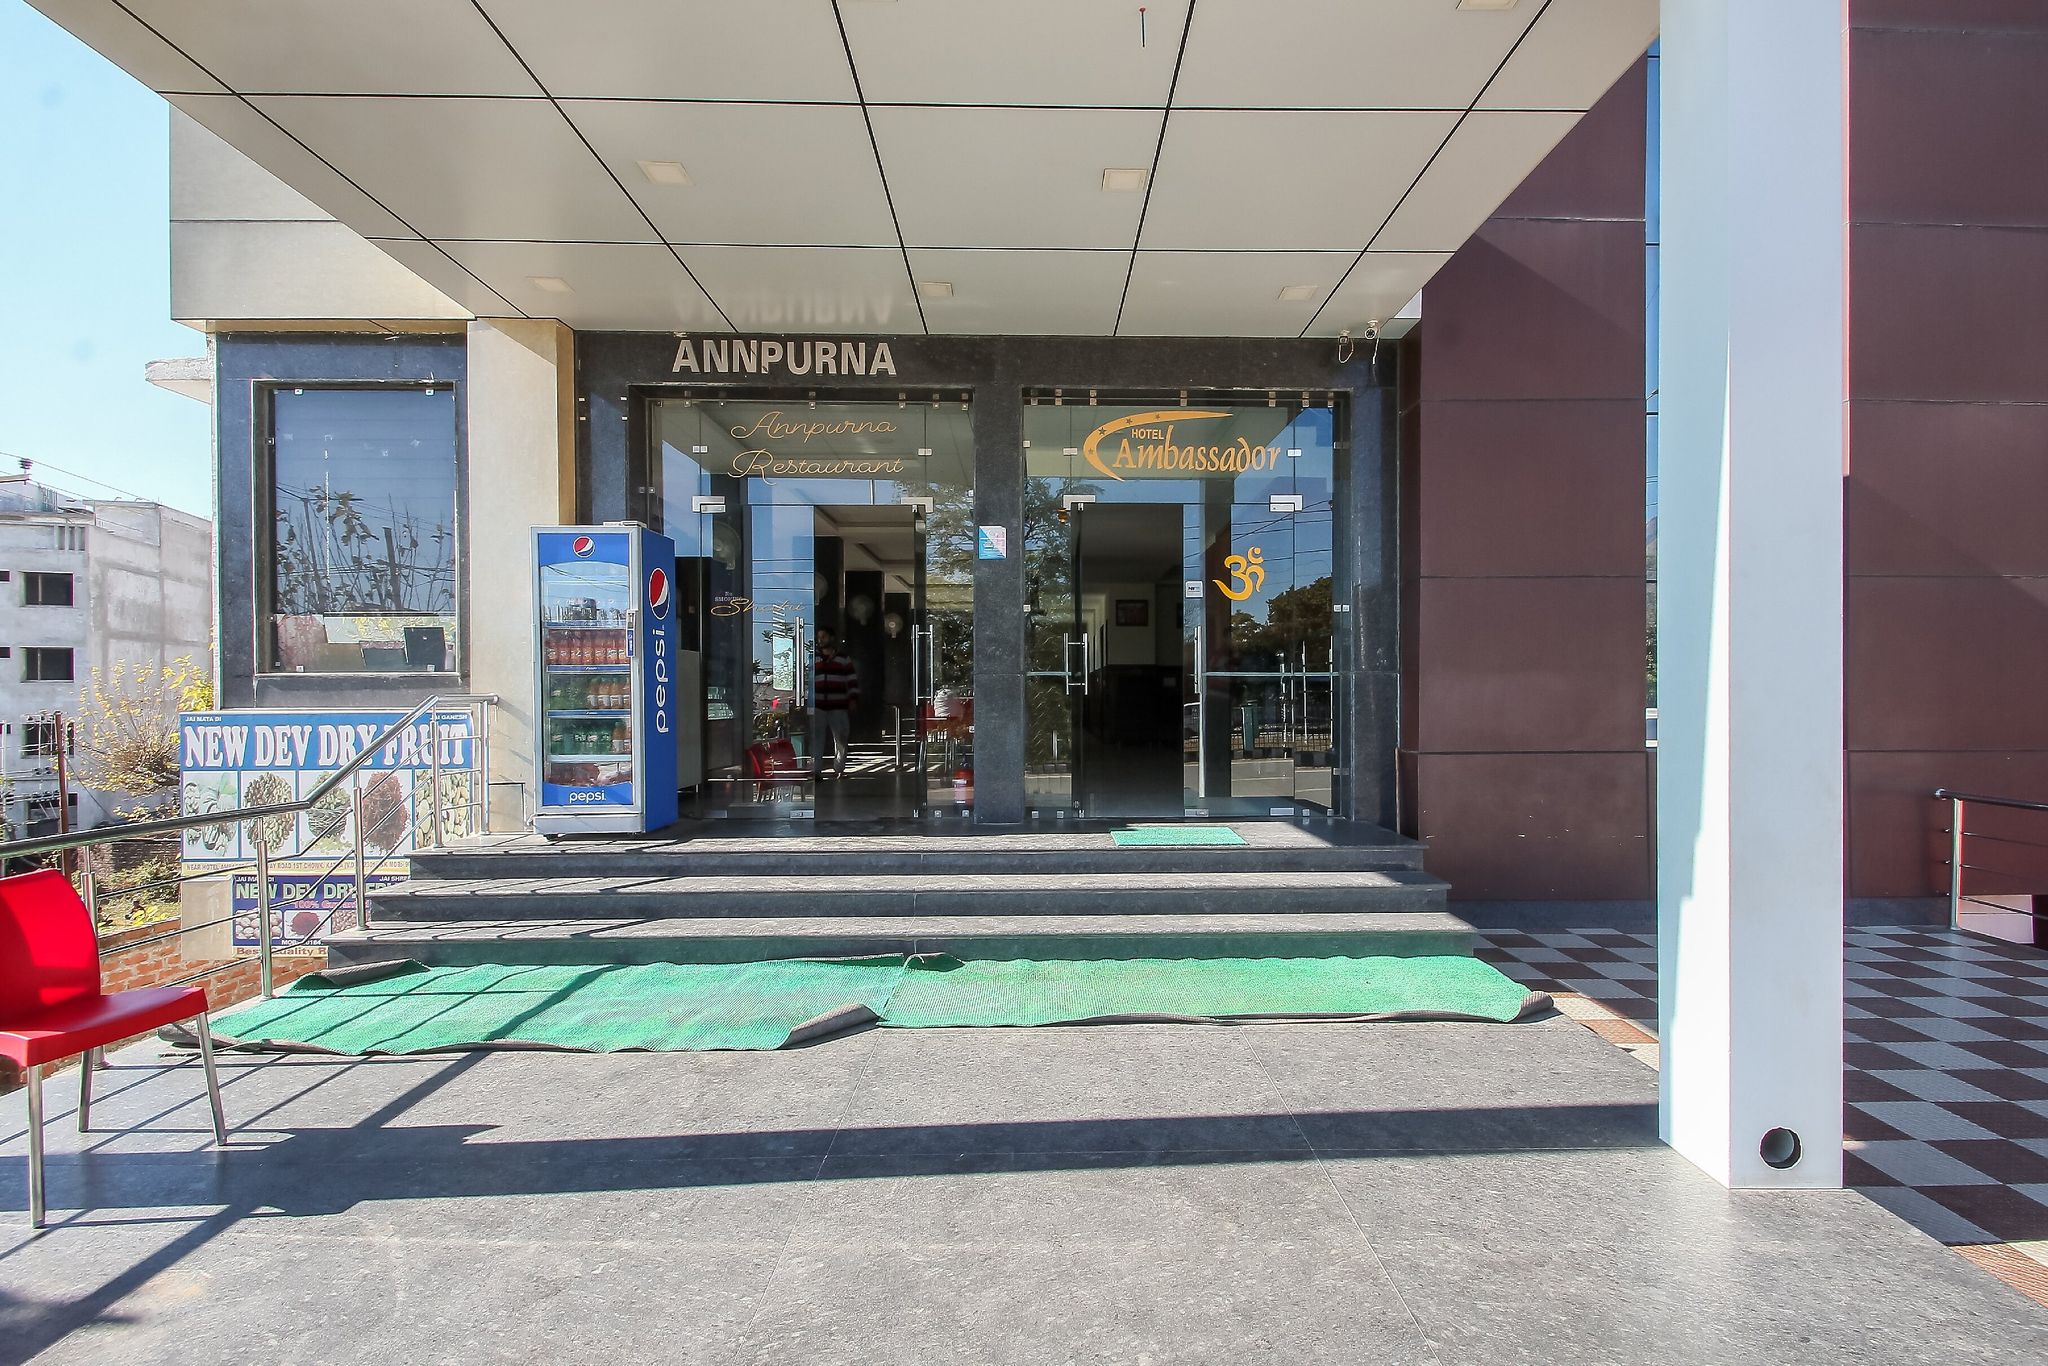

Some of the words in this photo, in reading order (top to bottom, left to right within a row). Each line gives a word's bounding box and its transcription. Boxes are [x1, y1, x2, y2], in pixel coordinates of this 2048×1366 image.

[672, 339, 897, 376] ANNPURNA
[730, 411, 897, 443] Annpurna
[1131, 428, 1165, 440] HOTEL
[1112, 424, 1281, 472] Ambassador
[727, 448, 904, 486] Restaurant
[652, 625, 669, 733] pepsi
[184, 725, 249, 767] NEW
[254, 725, 313, 767] DEV
[318, 724, 378, 766] DRY
[383, 723, 469, 765] FRUIT
[569, 789, 605, 804] pepsi
[282, 883, 319, 899] DEV
[236, 947, 260, 955] Bes
